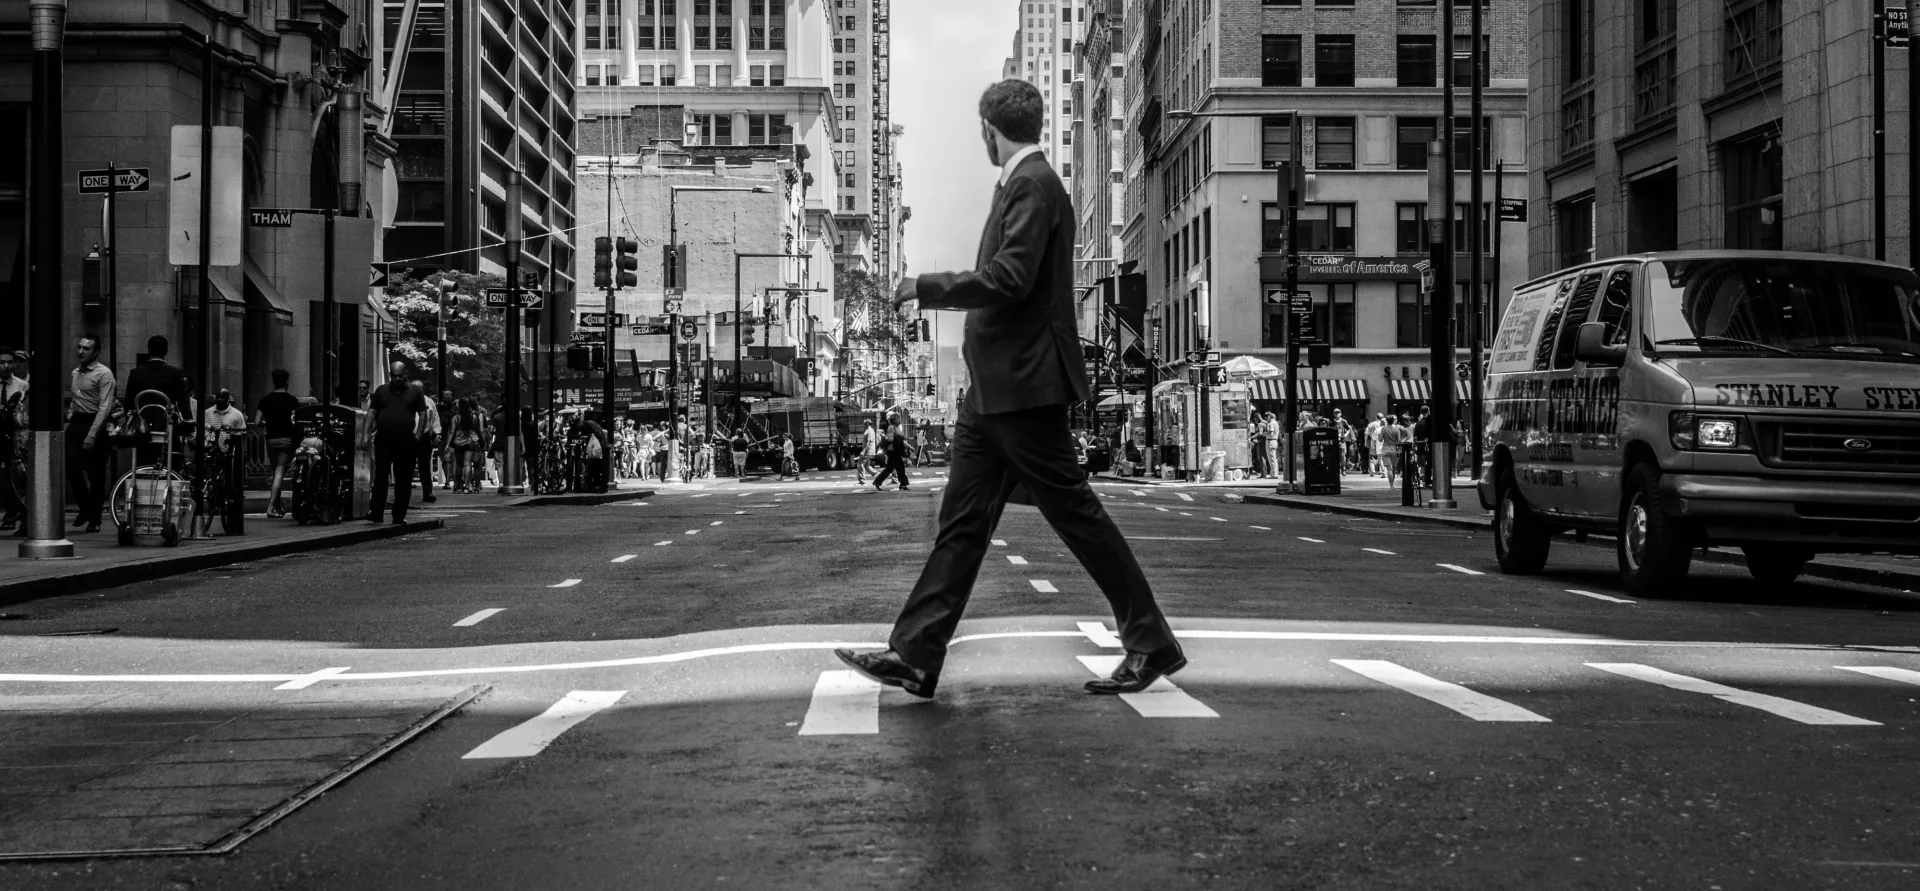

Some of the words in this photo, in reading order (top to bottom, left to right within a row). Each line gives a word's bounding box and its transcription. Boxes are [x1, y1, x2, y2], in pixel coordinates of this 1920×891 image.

[1888, 12, 1898, 20] NO
[85, 177, 108, 187] ONE
[119, 175, 141, 185] WAY
[1312, 257, 1337, 265] CEDAR
[1342, 261, 1357, 274] of
[1357, 261, 1409, 274] America
[1714, 383, 1840, 409] STANLEY
[1548, 376, 1620, 434] STEEMER
